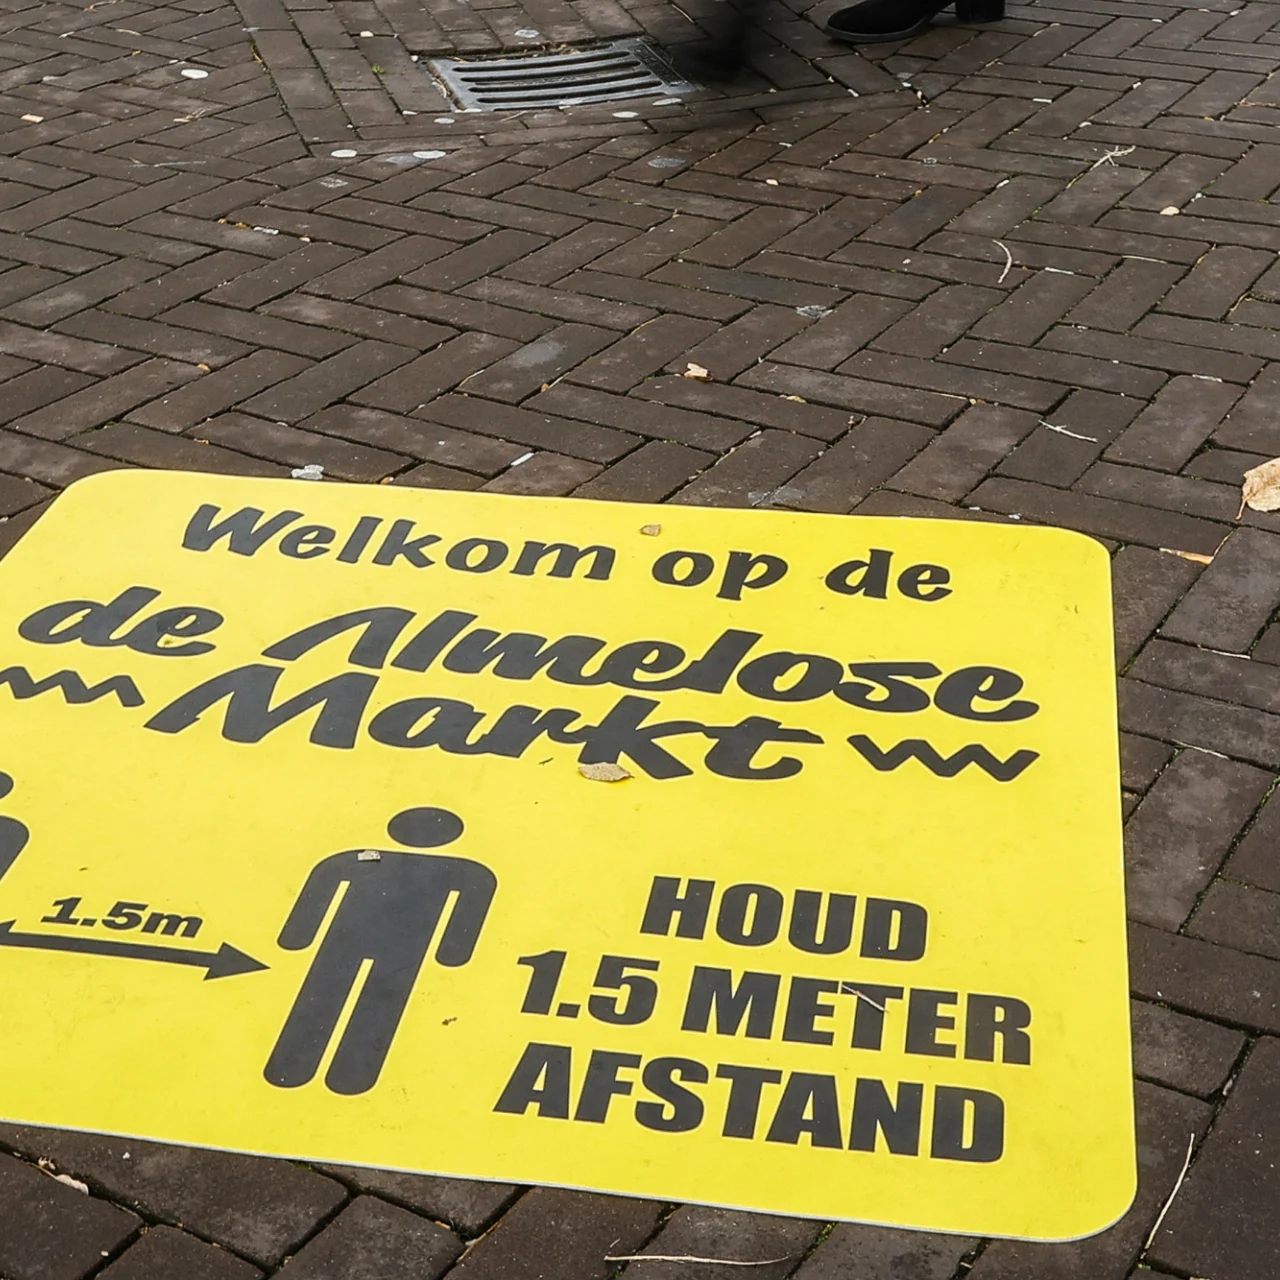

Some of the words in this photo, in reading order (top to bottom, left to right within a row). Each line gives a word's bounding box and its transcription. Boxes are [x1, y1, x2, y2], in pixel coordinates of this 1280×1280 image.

[182, 502, 614, 583] Welkom
[651, 549, 787, 601] op
[825, 548, 953, 602] de
[16, 585, 223, 658] de
[261, 606, 1040, 721] Almelose
[144, 663, 824, 781] Markt
[40, 896, 204, 939] 1.5m
[639, 875, 929, 962] HOUD
[516, 949, 660, 1026] 1.5
[680, 965, 1032, 1066] METER
[492, 1040, 1006, 1164] AFSTAND
